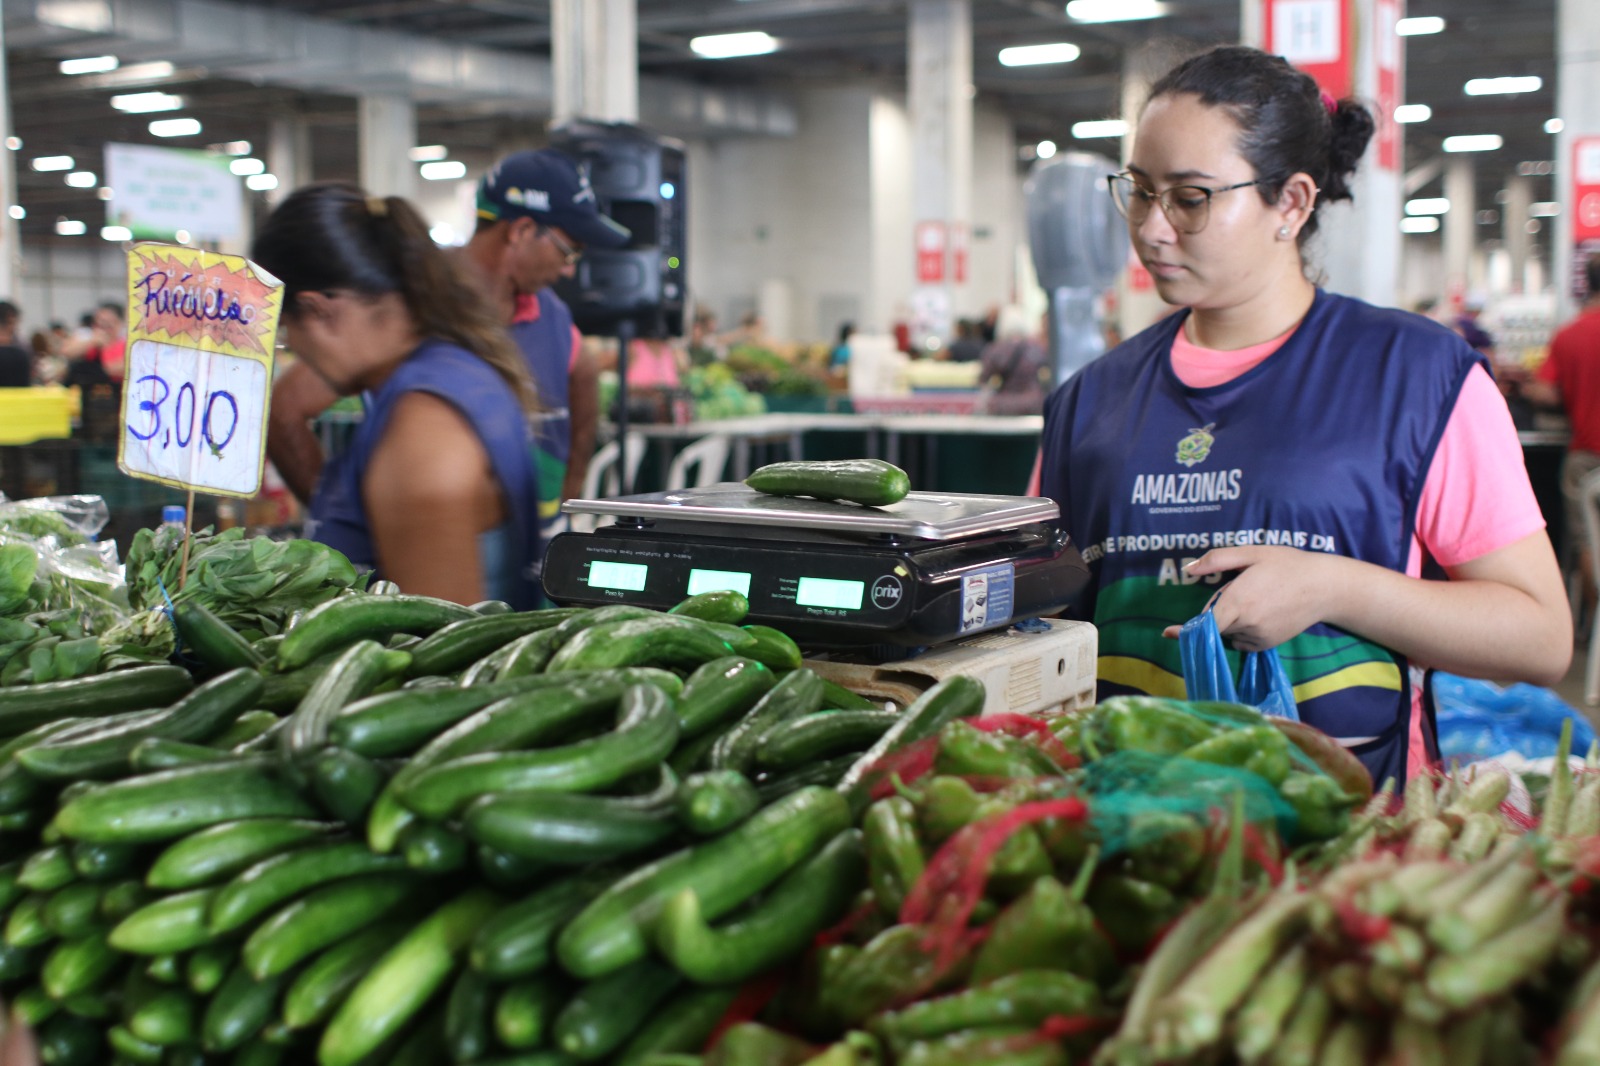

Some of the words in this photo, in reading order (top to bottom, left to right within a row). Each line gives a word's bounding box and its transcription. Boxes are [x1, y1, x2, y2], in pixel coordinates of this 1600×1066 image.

[128, 375, 238, 450] 3,00
[1131, 468, 1242, 504] AMAZONAS
[1195, 504, 1222, 512] ESTADO
[1118, 533, 1210, 551] PRODUTOS
[1213, 528, 1308, 547] REGIONAIS
[1311, 534, 1336, 552] DA
[875, 585, 900, 599] prix
